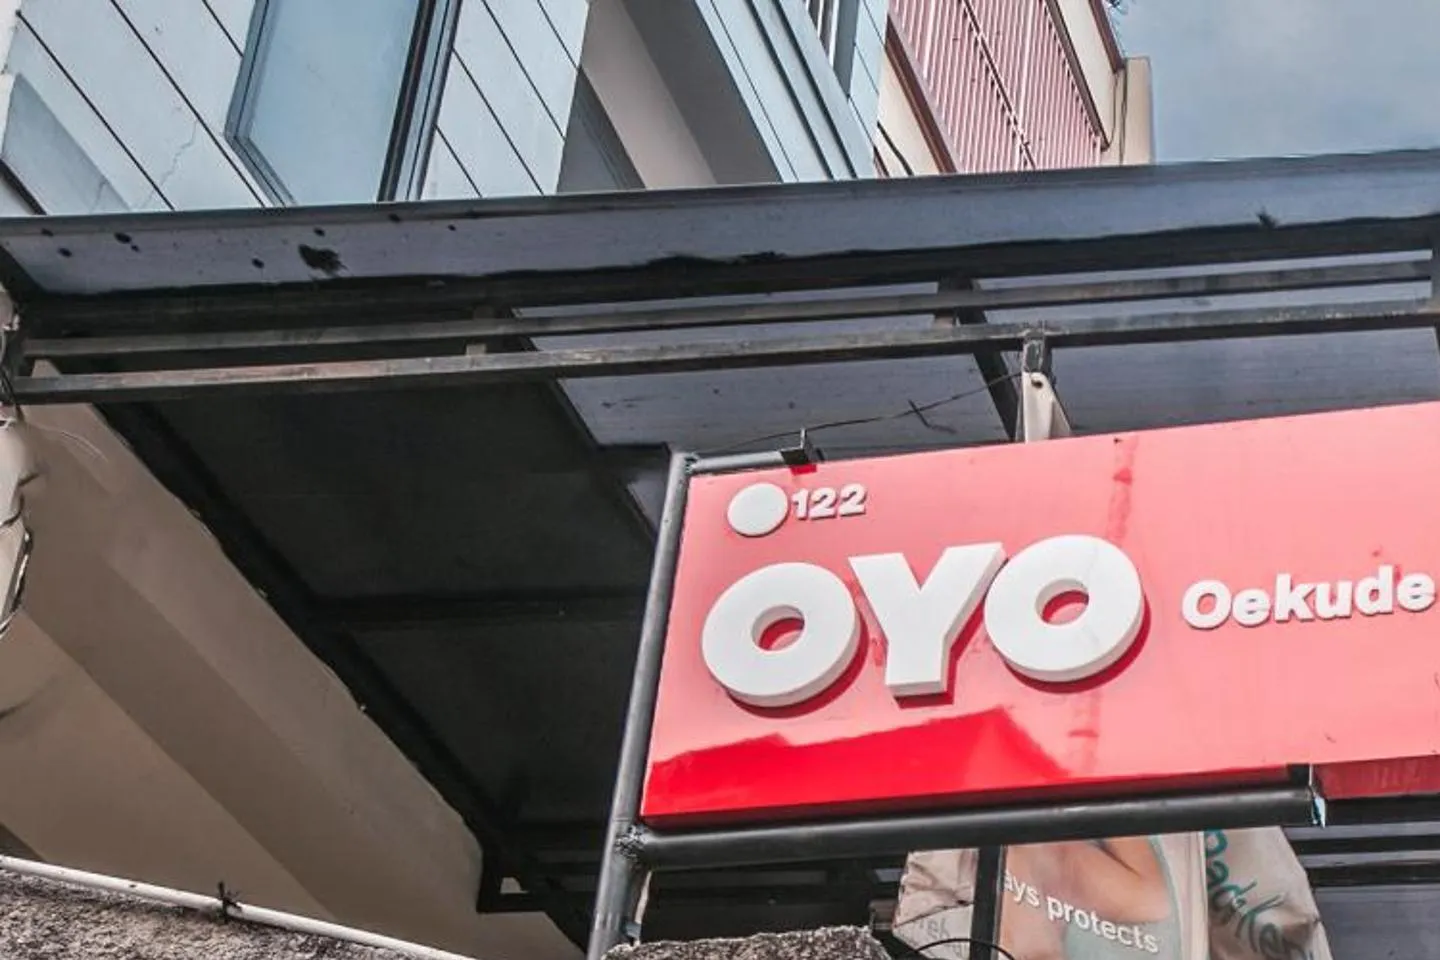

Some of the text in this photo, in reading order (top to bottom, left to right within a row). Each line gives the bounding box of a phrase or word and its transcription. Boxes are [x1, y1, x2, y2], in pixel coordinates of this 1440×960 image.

[791, 483, 867, 520] 122
[701, 534, 1146, 708] OYO
[1181, 564, 1436, 630] Oekude
[1046, 895, 1159, 953] protects
